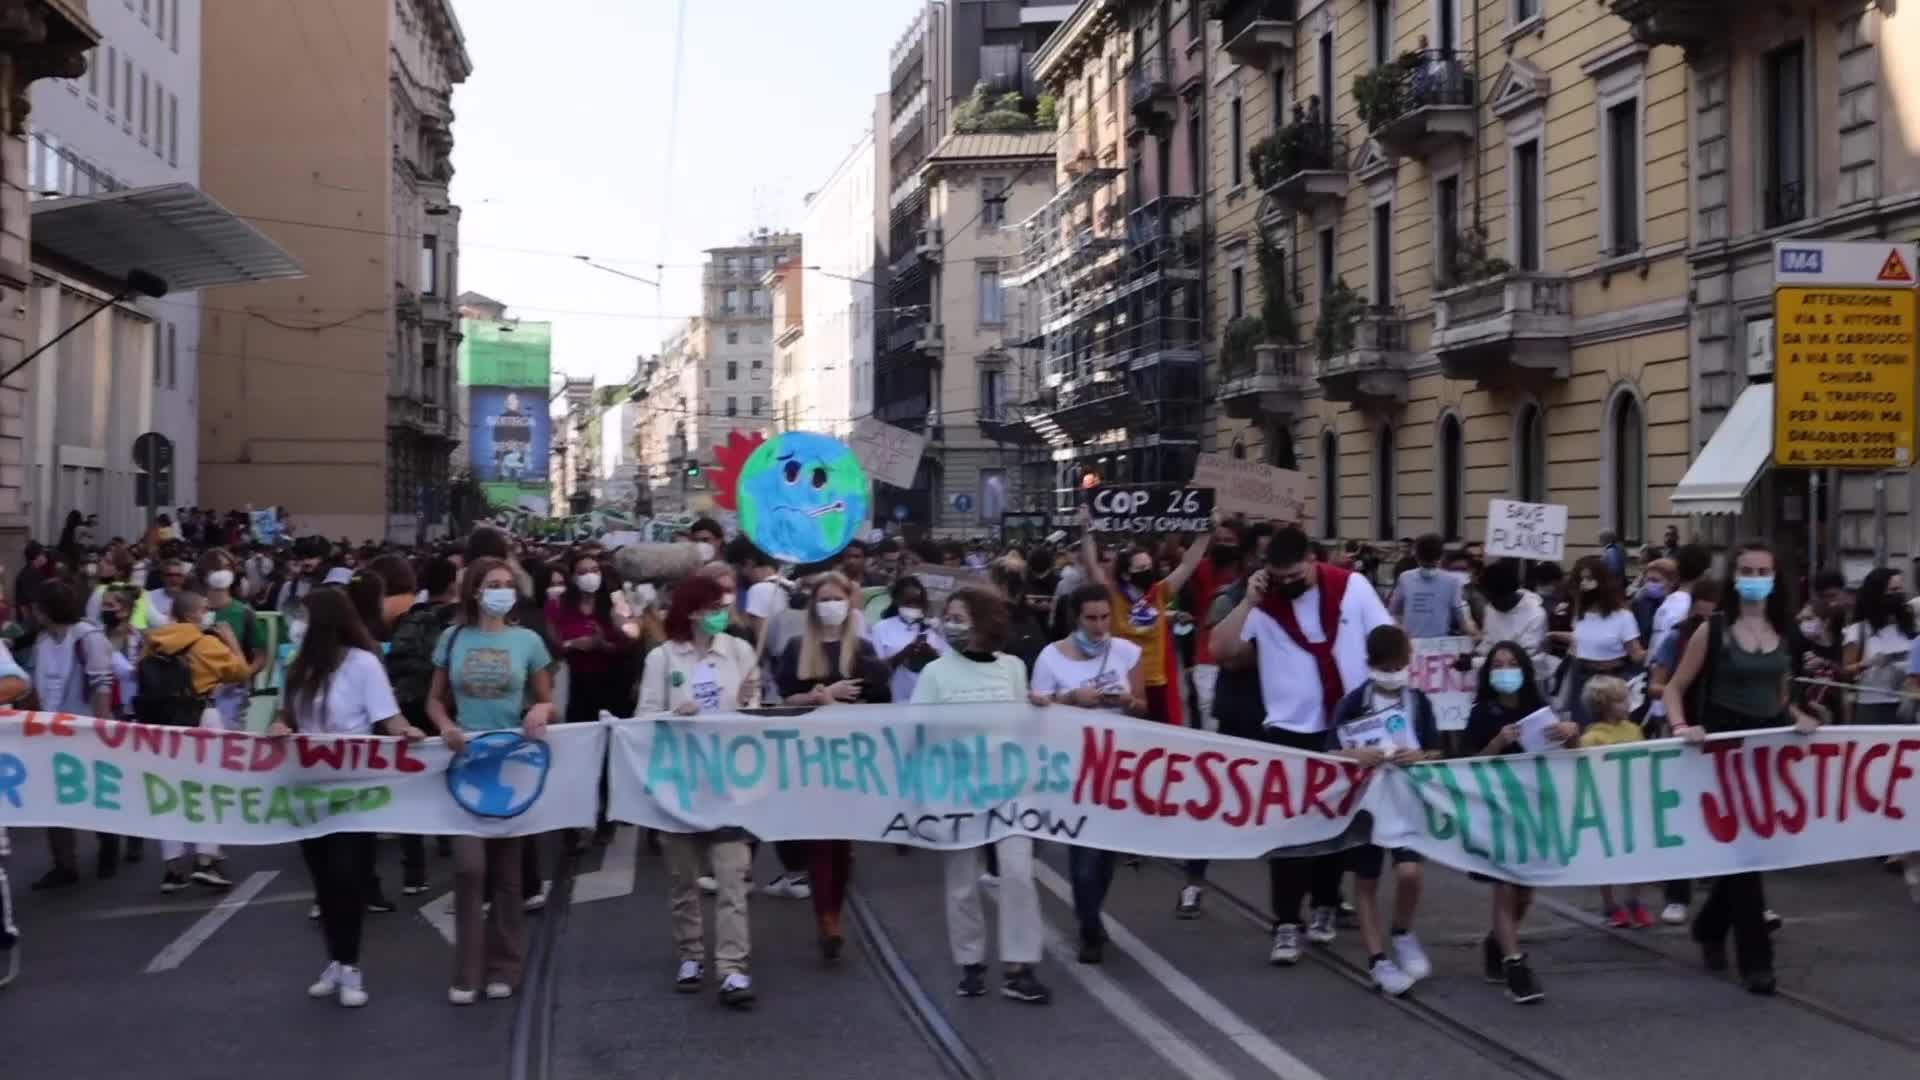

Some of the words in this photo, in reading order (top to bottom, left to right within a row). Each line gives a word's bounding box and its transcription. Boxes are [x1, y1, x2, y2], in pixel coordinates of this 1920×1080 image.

[1801, 294, 1893, 307] ATTENZIONE
[1825, 391, 1896, 404] TRAFFICO
[1093, 489, 1150, 514] COP
[1166, 490, 1201, 514] 26
[1506, 503, 1545, 522] SAVE
[1493, 527, 1564, 556] PLANET
[93, 718, 287, 772] UNITED
[296, 735, 427, 774] WILL
[52, 751, 123, 811] BE
[645, 719, 887, 812] ANOTHER
[1073, 726, 1376, 827] NECESSARY
[1702, 738, 1920, 844] JUSTICE
[882, 812, 975, 844] ACT
[984, 801, 1088, 841] NOW
[1406, 747, 1684, 866] CLIMATE
